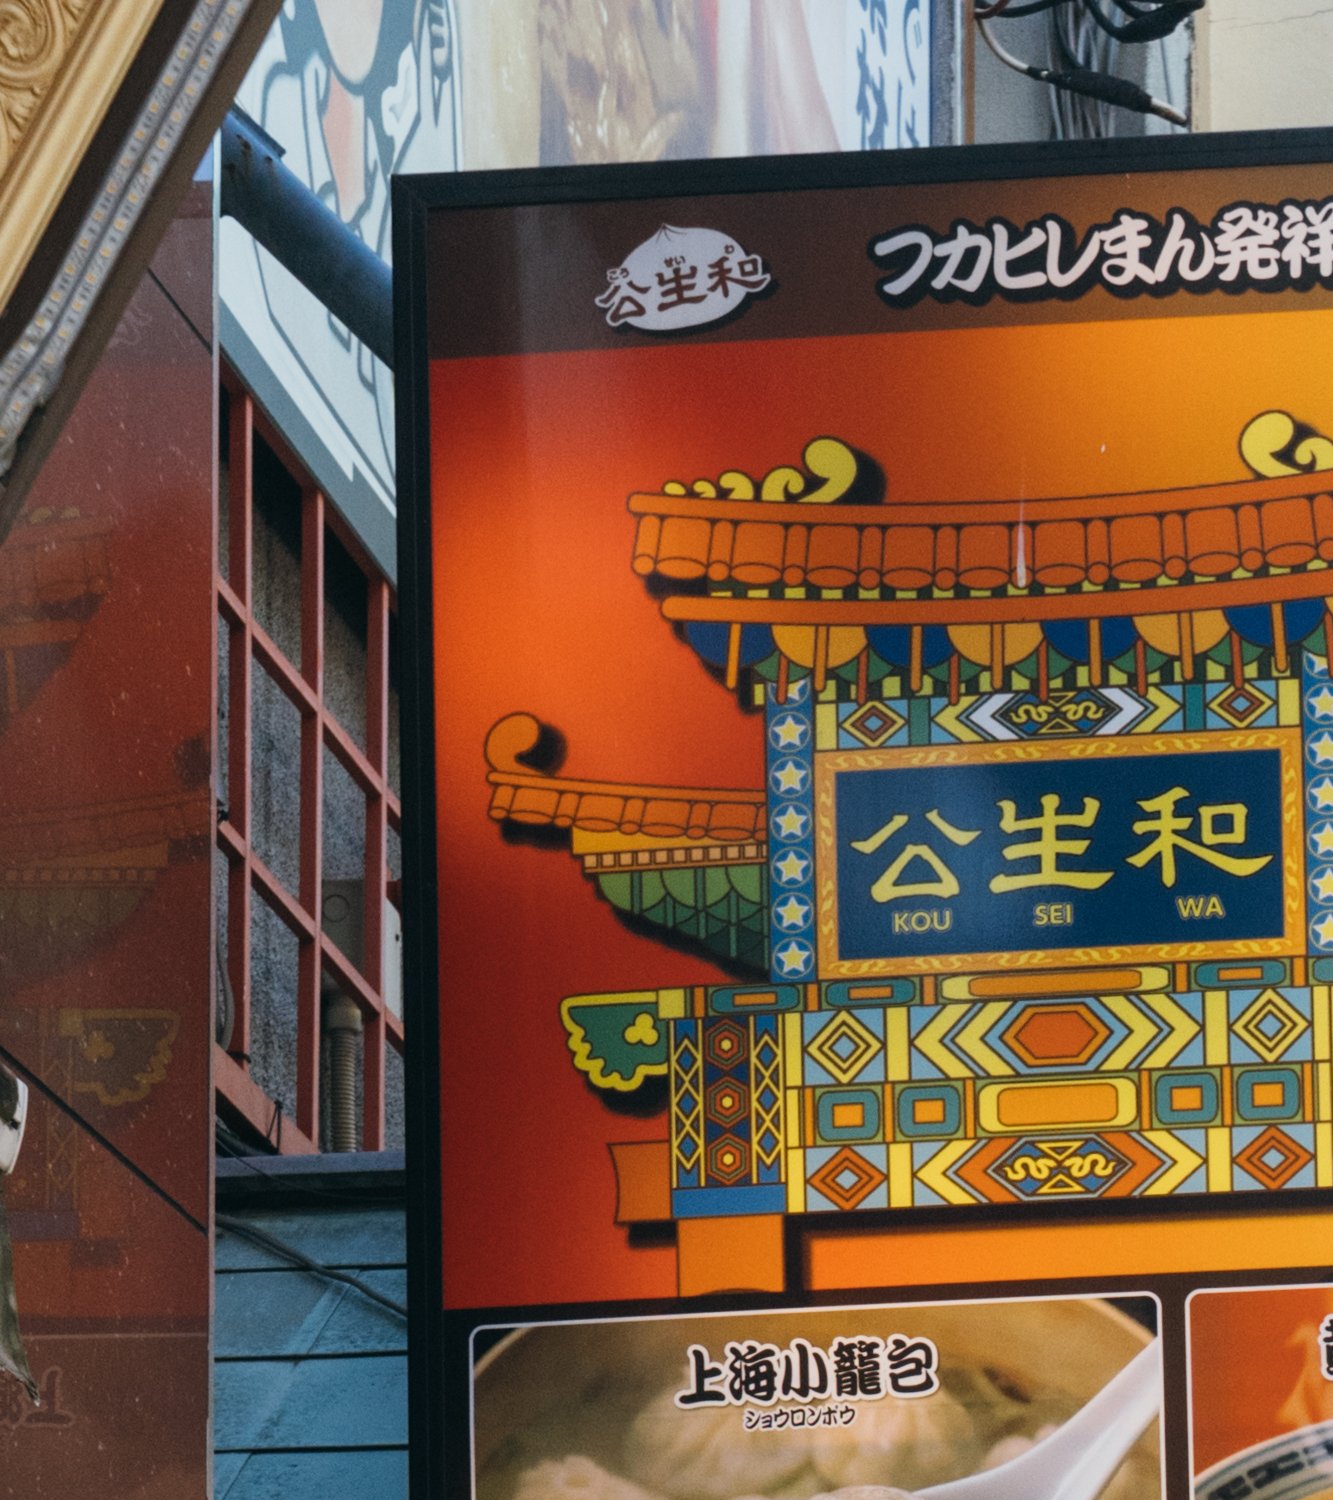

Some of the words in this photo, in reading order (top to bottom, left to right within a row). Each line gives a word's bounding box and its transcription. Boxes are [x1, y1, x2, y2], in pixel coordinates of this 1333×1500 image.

[599, 255, 770, 322] 公生和
[849, 786, 1275, 903] 公生和
[893, 909, 953, 934] KOU
[1033, 902, 1075, 927] SEI
[1177, 896, 1224, 920] WA
[676, 1334, 940, 1408] 上海小籠包
